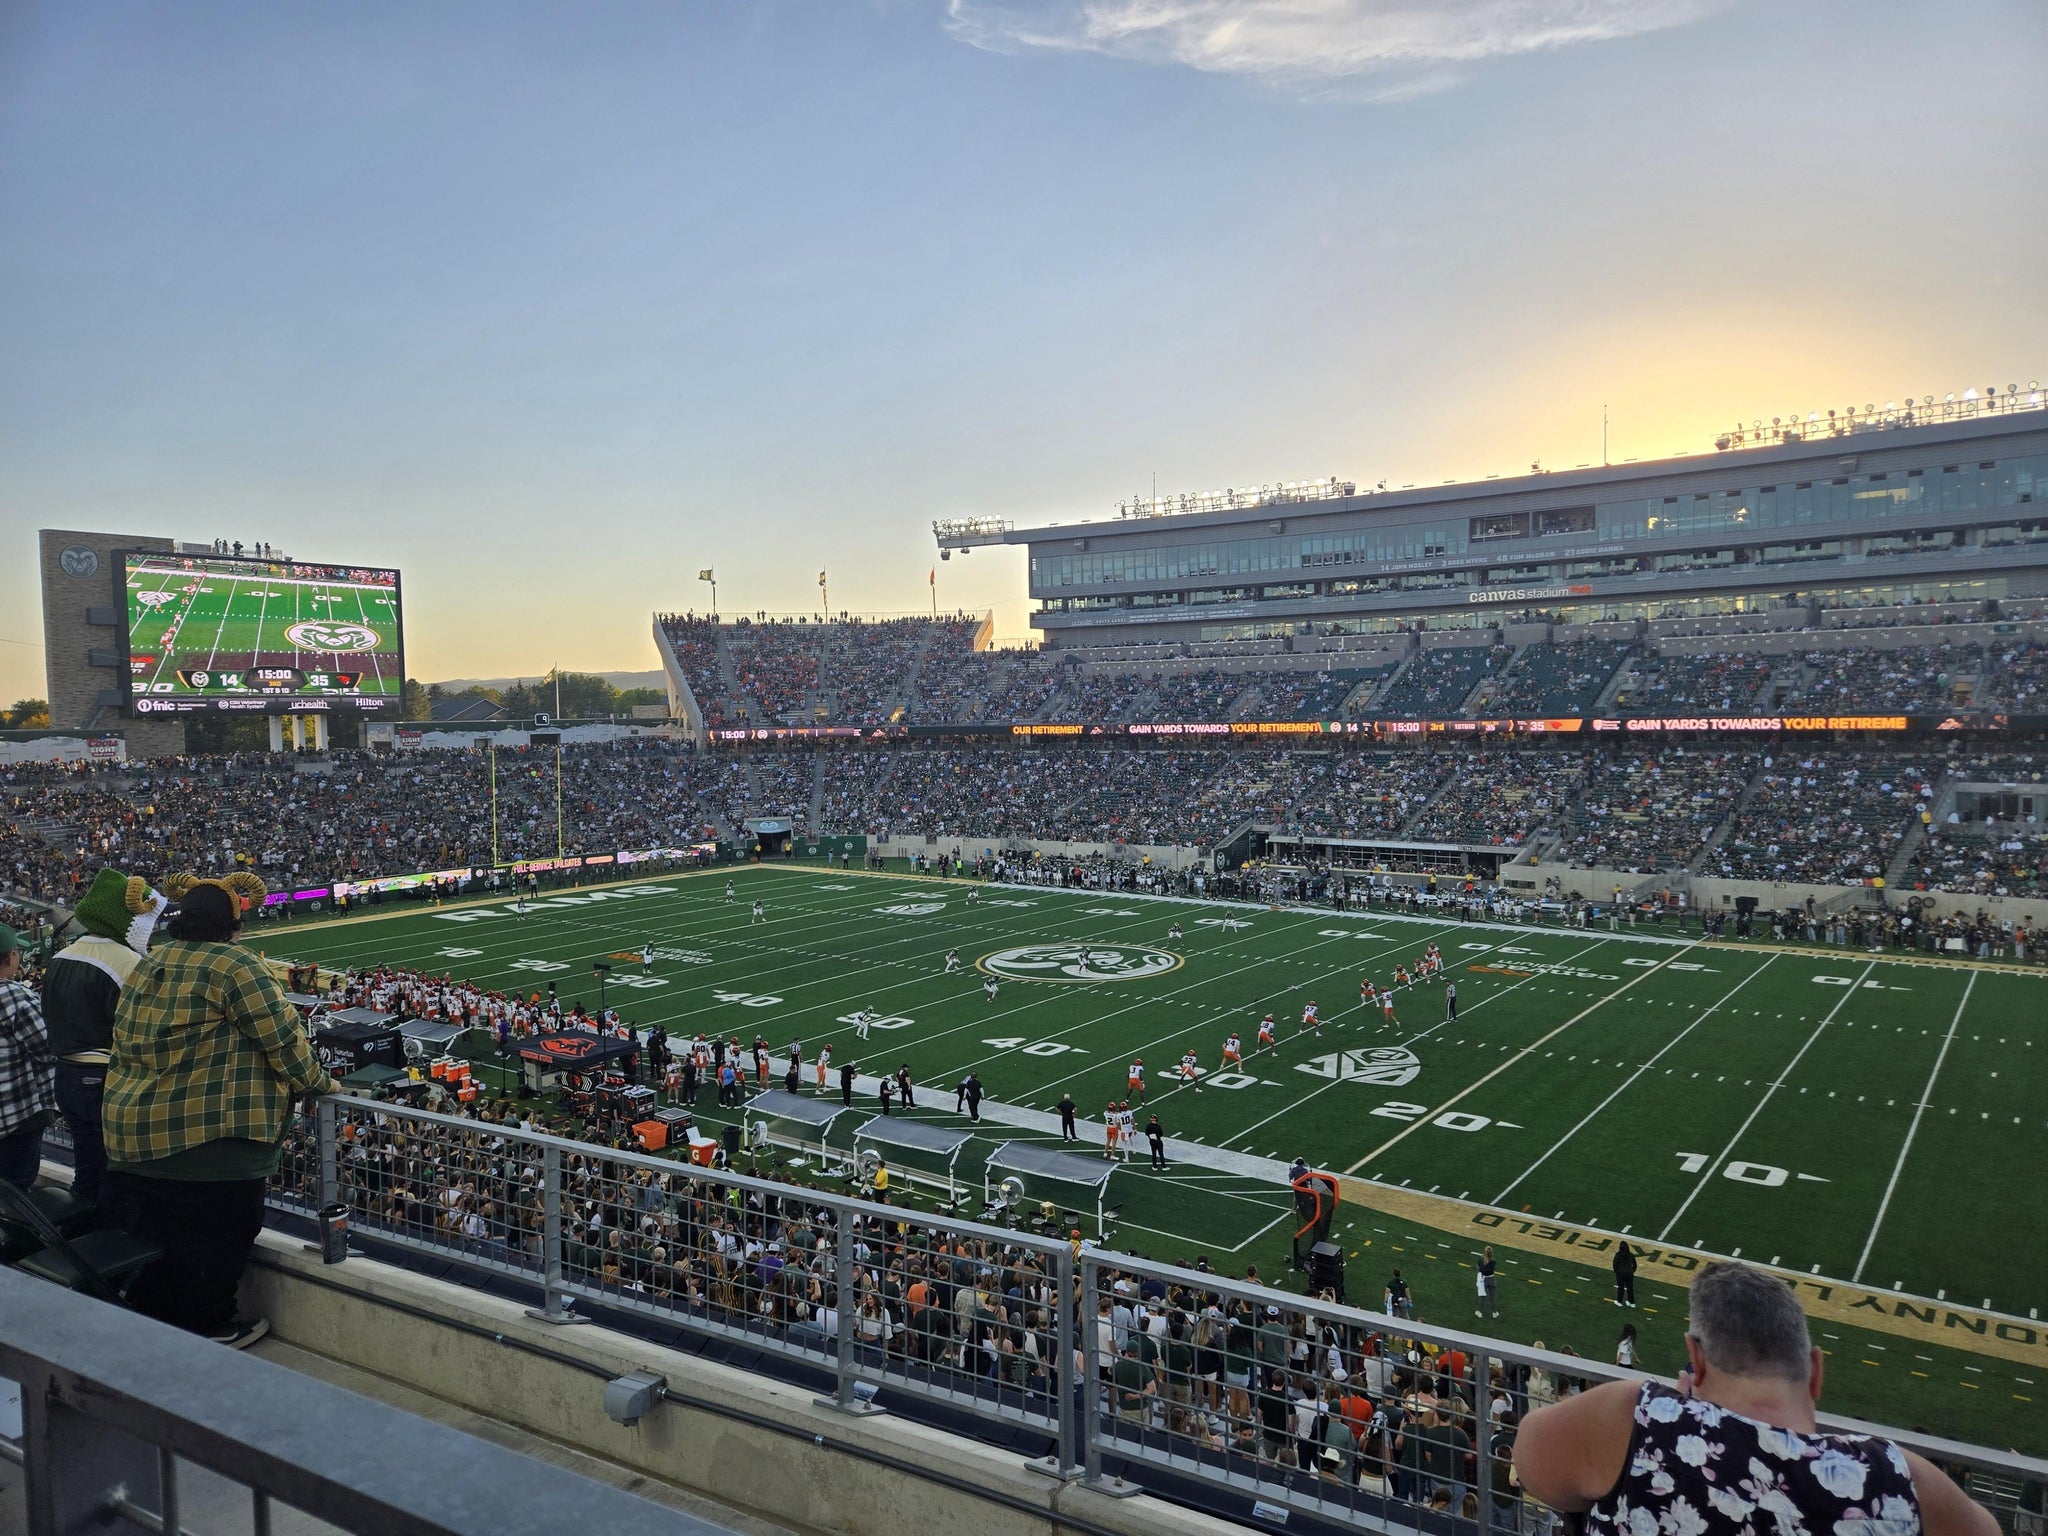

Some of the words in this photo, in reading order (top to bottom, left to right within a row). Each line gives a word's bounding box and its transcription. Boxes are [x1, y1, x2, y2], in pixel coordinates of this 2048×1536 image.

[1469, 589, 1525, 602] canvas
[1526, 588, 1569, 600] stadium
[257, 669, 292, 679] 15:00
[220, 674, 238, 686] 14
[310, 675, 328, 686] 35
[153, 701, 176, 711] fnic
[291, 700, 328, 708] uchealth
[355, 698, 383, 706] Hilton
[1129, 724, 1151, 733] GAIN
[1152, 724, 1182, 733] YARDS
[1184, 724, 1229, 733] TOWARDS
[1230, 723, 1257, 732] YOUR
[1346, 723, 1358, 732] 14
[1392, 722, 1419, 732] 15:00
[1430, 723, 1445, 731] 3rd
[1530, 721, 1545, 731] 35
[1626, 719, 1660, 730] GAIN
[1662, 718, 1708, 730] YARDS
[1709, 718, 1781, 730] TOWARDS
[1782, 717, 1826, 729] YOUR
[1828, 717, 1907, 729] RETIREME
[721, 730, 745, 739] 15:00
[1013, 726, 1031, 735] OUR
[1032, 725, 1083, 734] RETIREMENT
[553, 857, 582, 870] TAILGATES
[431, 885, 679, 922] RAMS
[1486, 963, 1620, 981] canvas
[712, 993, 784, 1007] 40
[981, 1037, 1071, 1056] 40
[1157, 1065, 1258, 1089] 30
[1107, 1117, 1113, 1125] 2
[1121, 1116, 1131, 1125] 10
[1370, 1101, 1492, 1133] 20
[691, 1150, 701, 1161] G
[1675, 1152, 1789, 1187] 10
[1472, 1212, 1613, 1252] FIELD
[1849, 1296, 2048, 1348] ONNY
